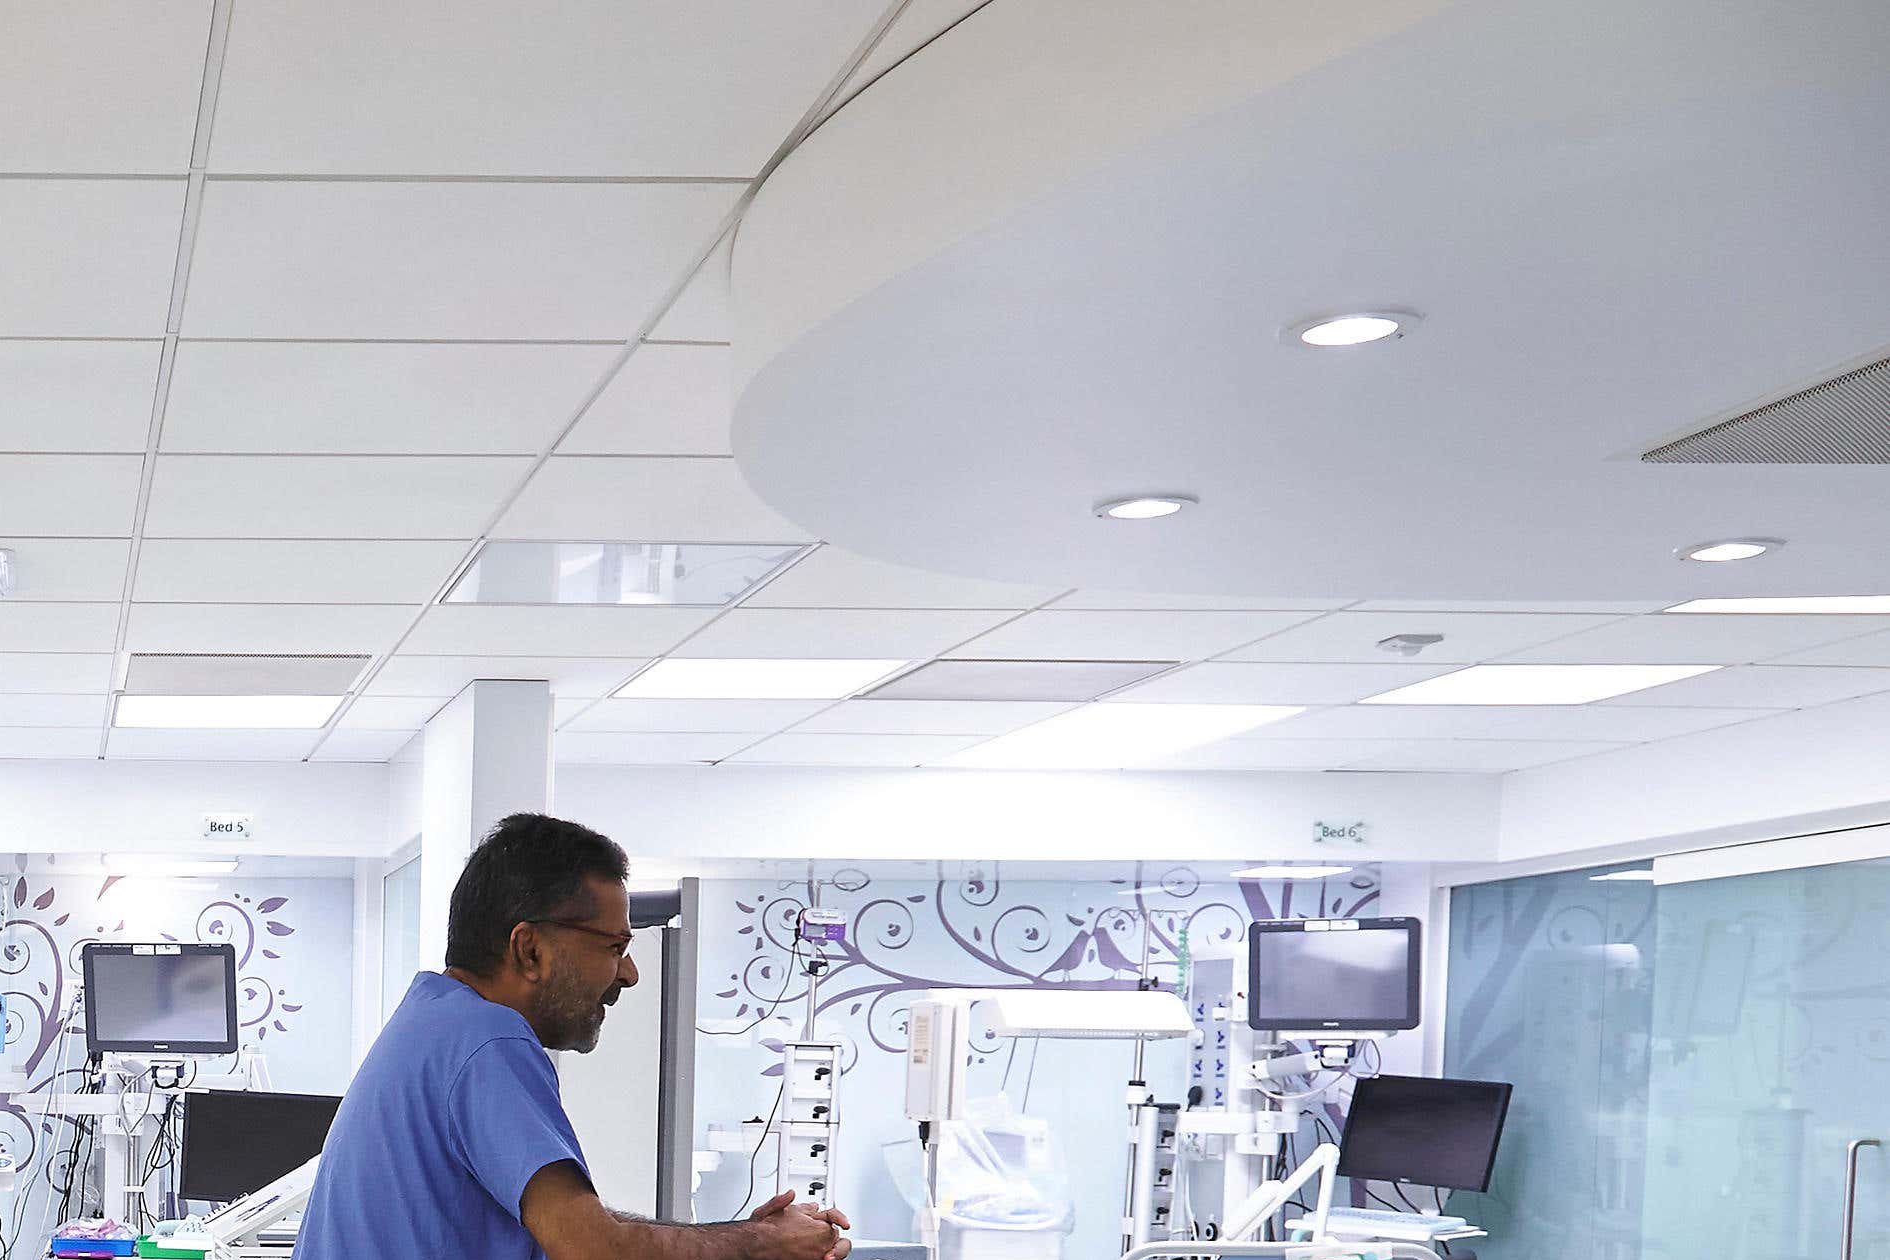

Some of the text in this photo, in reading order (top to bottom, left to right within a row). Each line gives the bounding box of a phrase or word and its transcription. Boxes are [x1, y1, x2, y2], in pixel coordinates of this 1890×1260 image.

[210, 821, 244, 832] Bed 5
[1322, 826, 1357, 837] Bed 6
